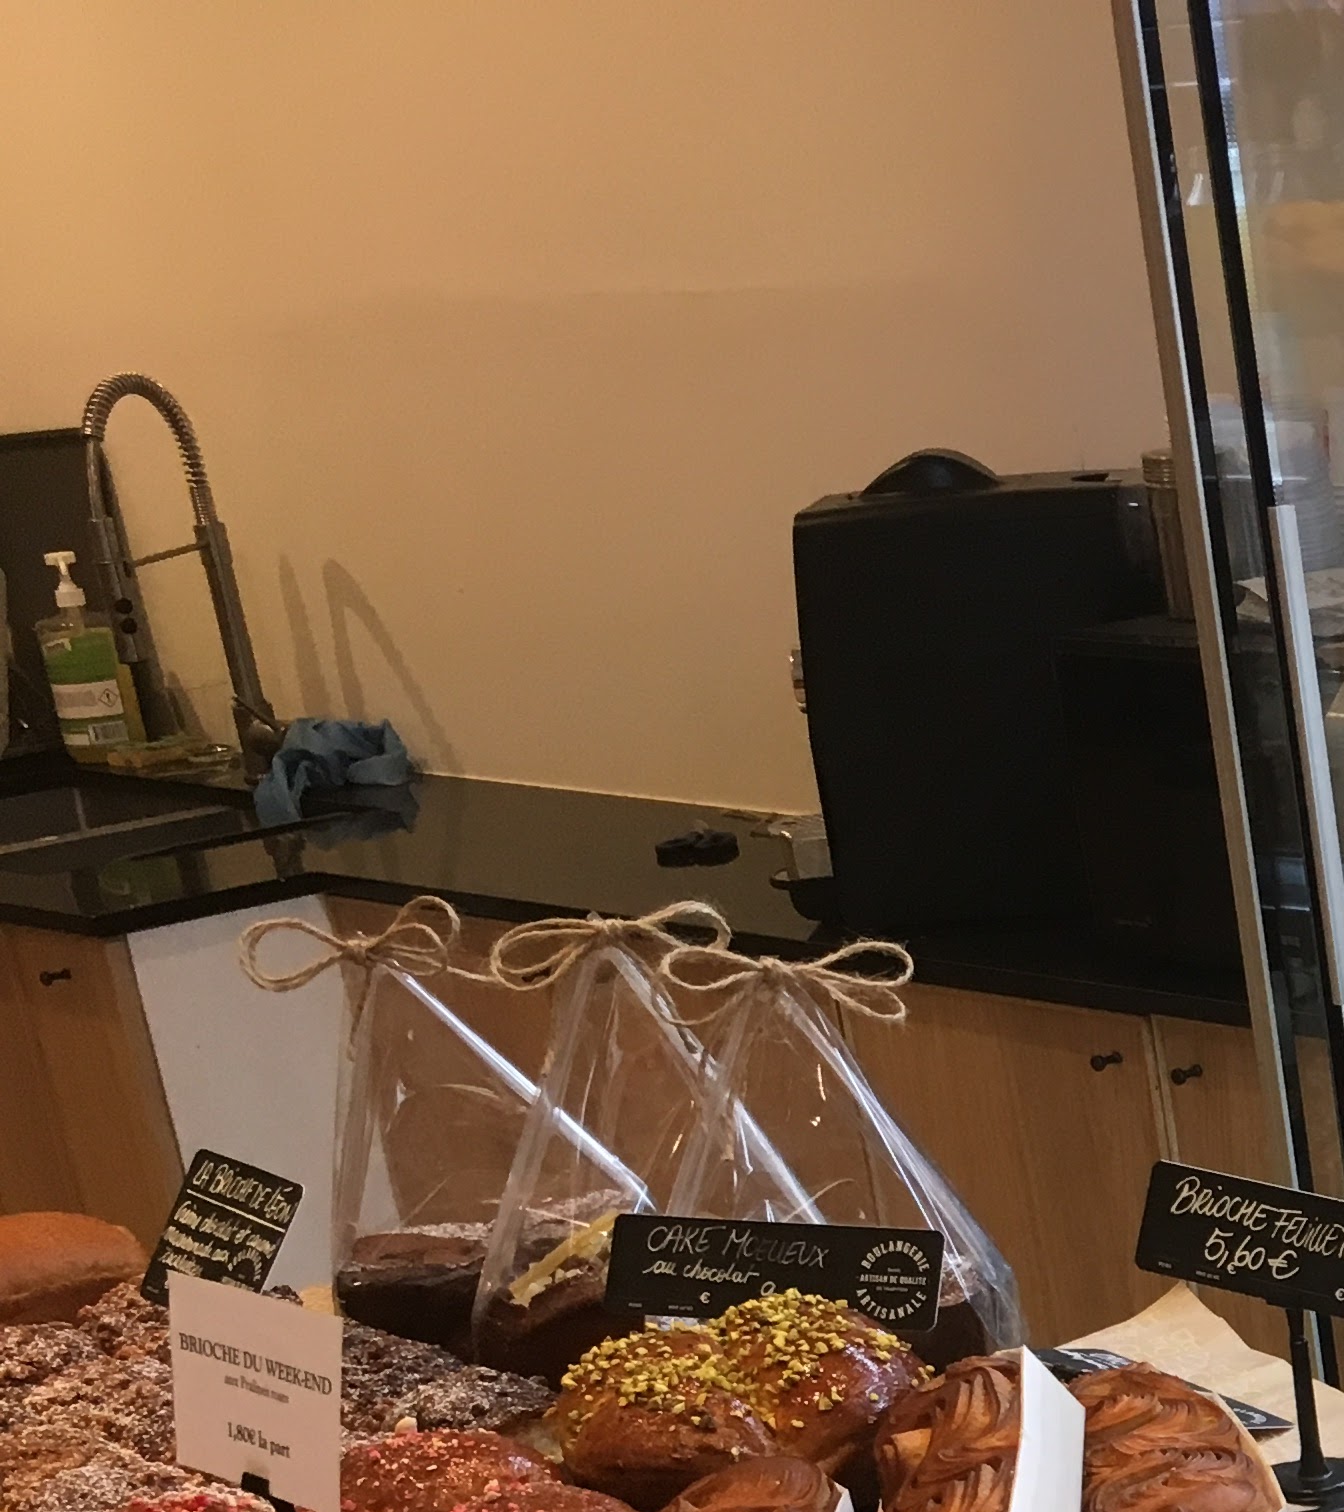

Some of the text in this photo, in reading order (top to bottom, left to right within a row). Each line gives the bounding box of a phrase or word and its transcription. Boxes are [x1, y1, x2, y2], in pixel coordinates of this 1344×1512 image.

[1170, 1175, 1279, 1231] BRIOCHE
[647, 1225, 726, 1254] CAKE
[861, 1241, 930, 1272] BOULANGERIE
[684, 1260, 759, 1285] chocolat
[856, 1289, 927, 1319] ARTISANALE
[179, 1333, 332, 1395] BRIOCHE DU WEEK-END
[228, 1422, 290, 1458] 1,80€ la part
